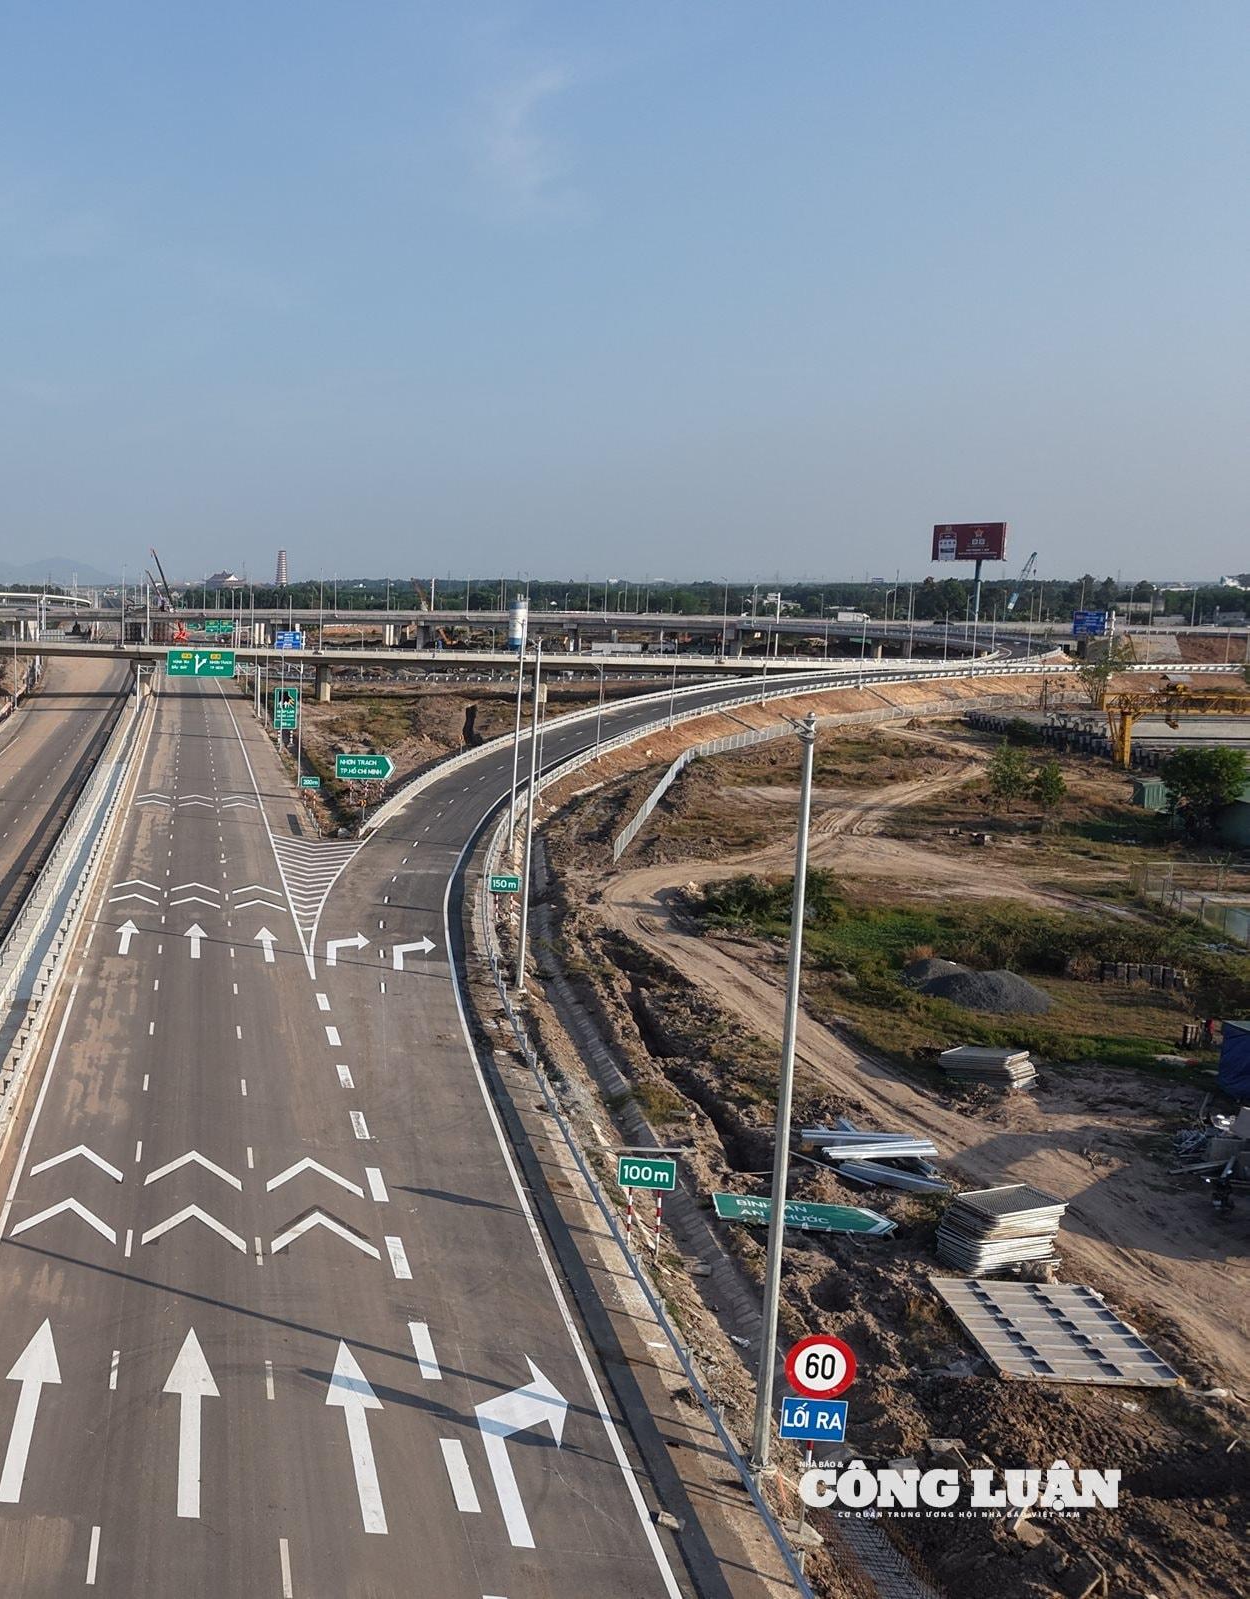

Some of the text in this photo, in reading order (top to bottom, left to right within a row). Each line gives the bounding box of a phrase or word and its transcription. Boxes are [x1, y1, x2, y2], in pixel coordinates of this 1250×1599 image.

[805, 1353, 836, 1380] 60
[783, 1402, 842, 1431] LỐI RA
